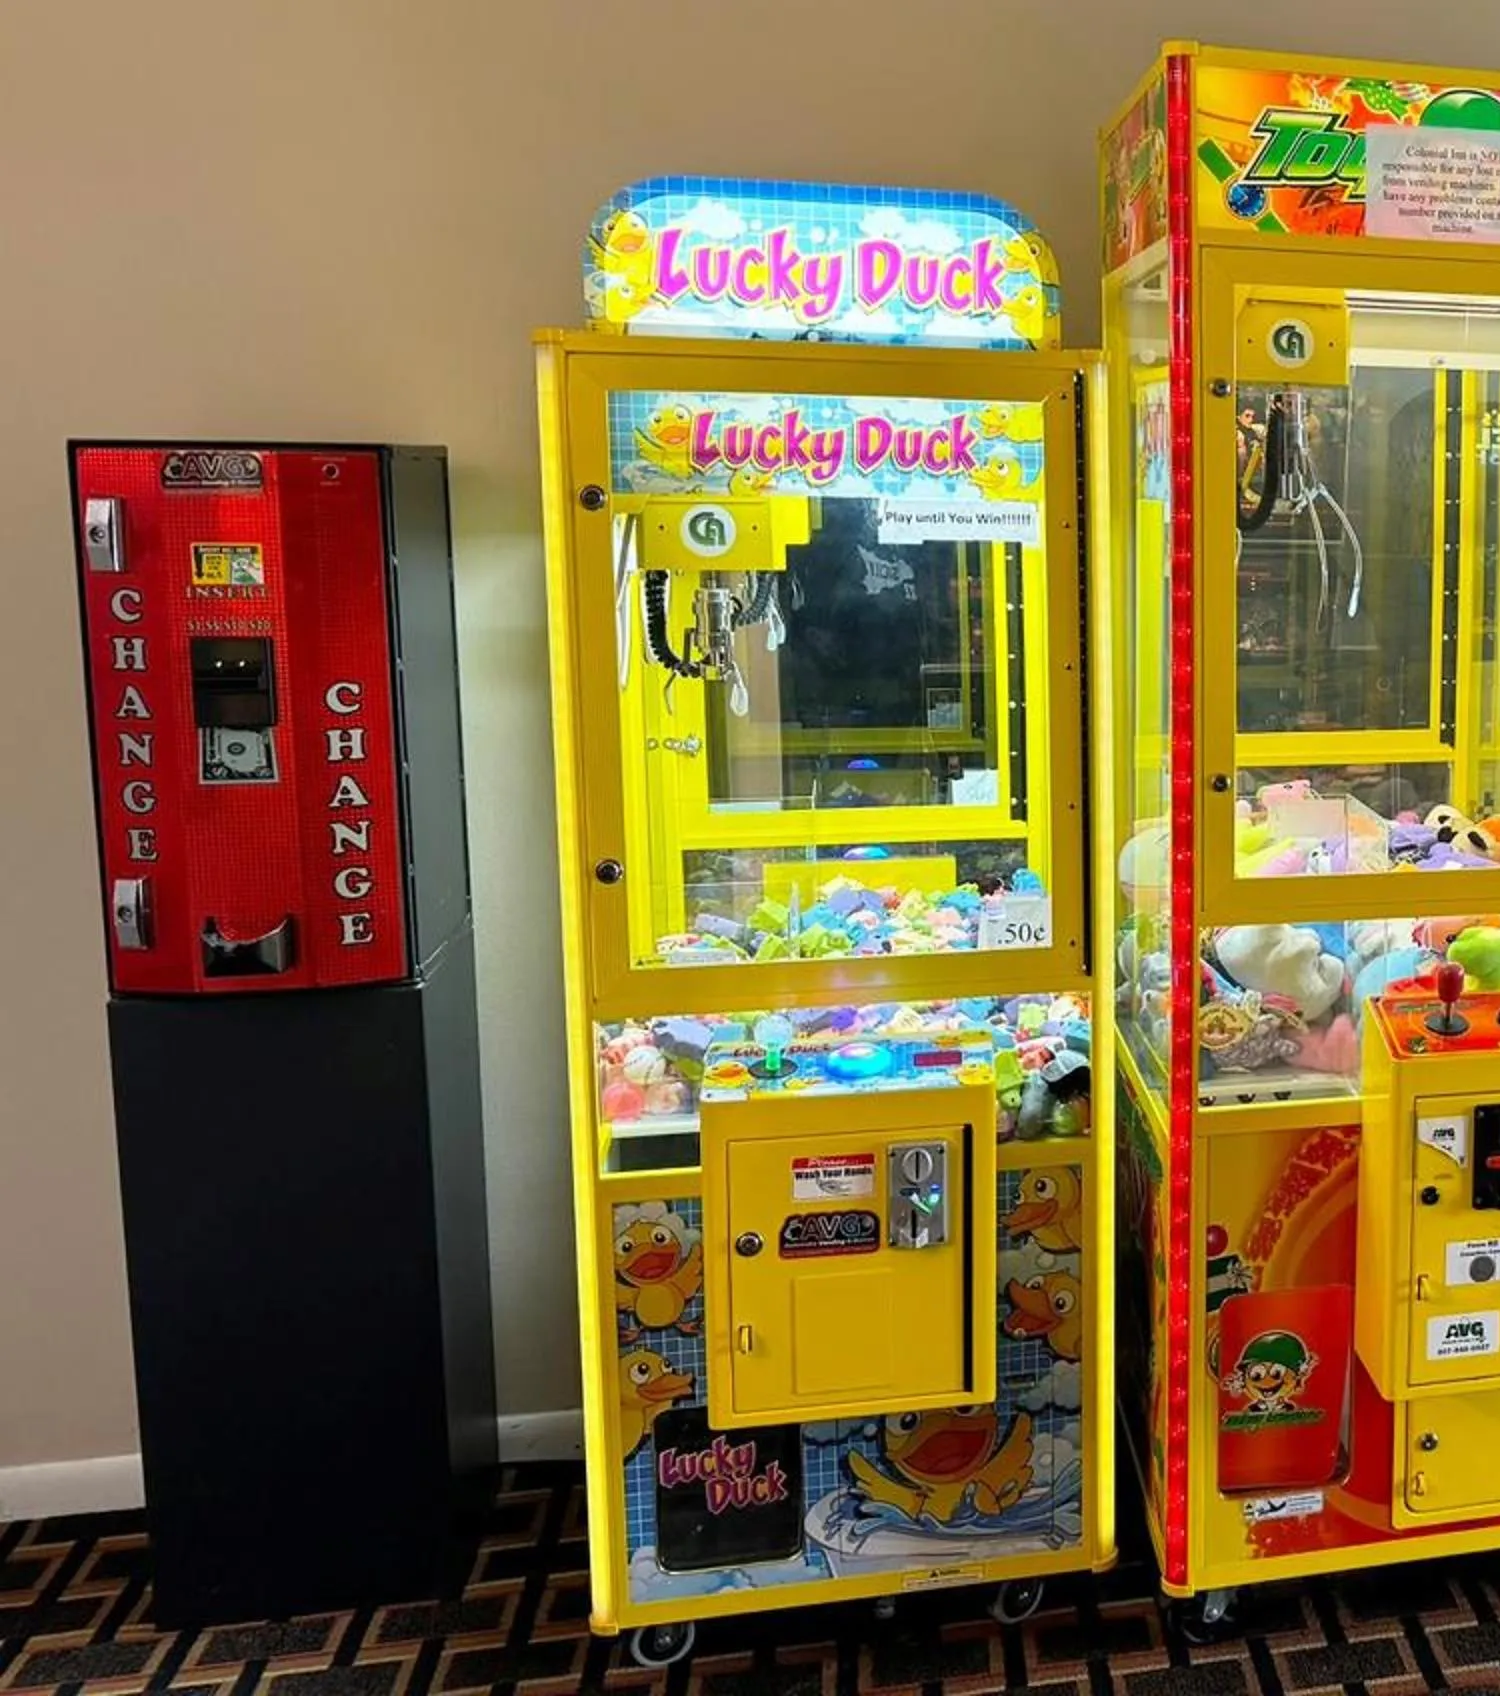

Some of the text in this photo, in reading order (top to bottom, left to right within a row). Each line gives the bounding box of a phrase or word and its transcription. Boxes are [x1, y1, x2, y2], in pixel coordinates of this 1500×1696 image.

[1406, 146, 1448, 158] Colonial
[1451, 149, 1466, 158] Inn
[1382, 162, 1438, 174] responsible
[1440, 163, 1454, 174] for
[1456, 167, 1474, 177] any
[1476, 165, 1493, 175] lost
[1383, 175, 1406, 186] from
[1409, 177, 1447, 190] vending
[1384, 190, 1406, 201] have
[1408, 194, 1425, 204] any
[1429, 193, 1472, 205] problems
[1398, 207, 1436, 217] number
[1438, 208, 1480, 220] provided
[1482, 211, 1494, 220] on
[654, 229, 1006, 319] Lucky Duck
[690, 411, 977, 481] Lucky Duck
[886, 512, 913, 525] Play
[916, 512, 945, 525] until
[949, 513, 972, 525] You
[185, 587, 266, 598] INSERT
[110, 589, 159, 863] CHANGE
[325, 681, 374, 946] CHANGE
[997, 922, 1046, 945] .50¢
[796, 1170, 821, 1181] Wash
[1445, 1321, 1485, 1339] AVG
[659, 1434, 756, 1489] Lucky
[706, 1460, 789, 1515] Duck
